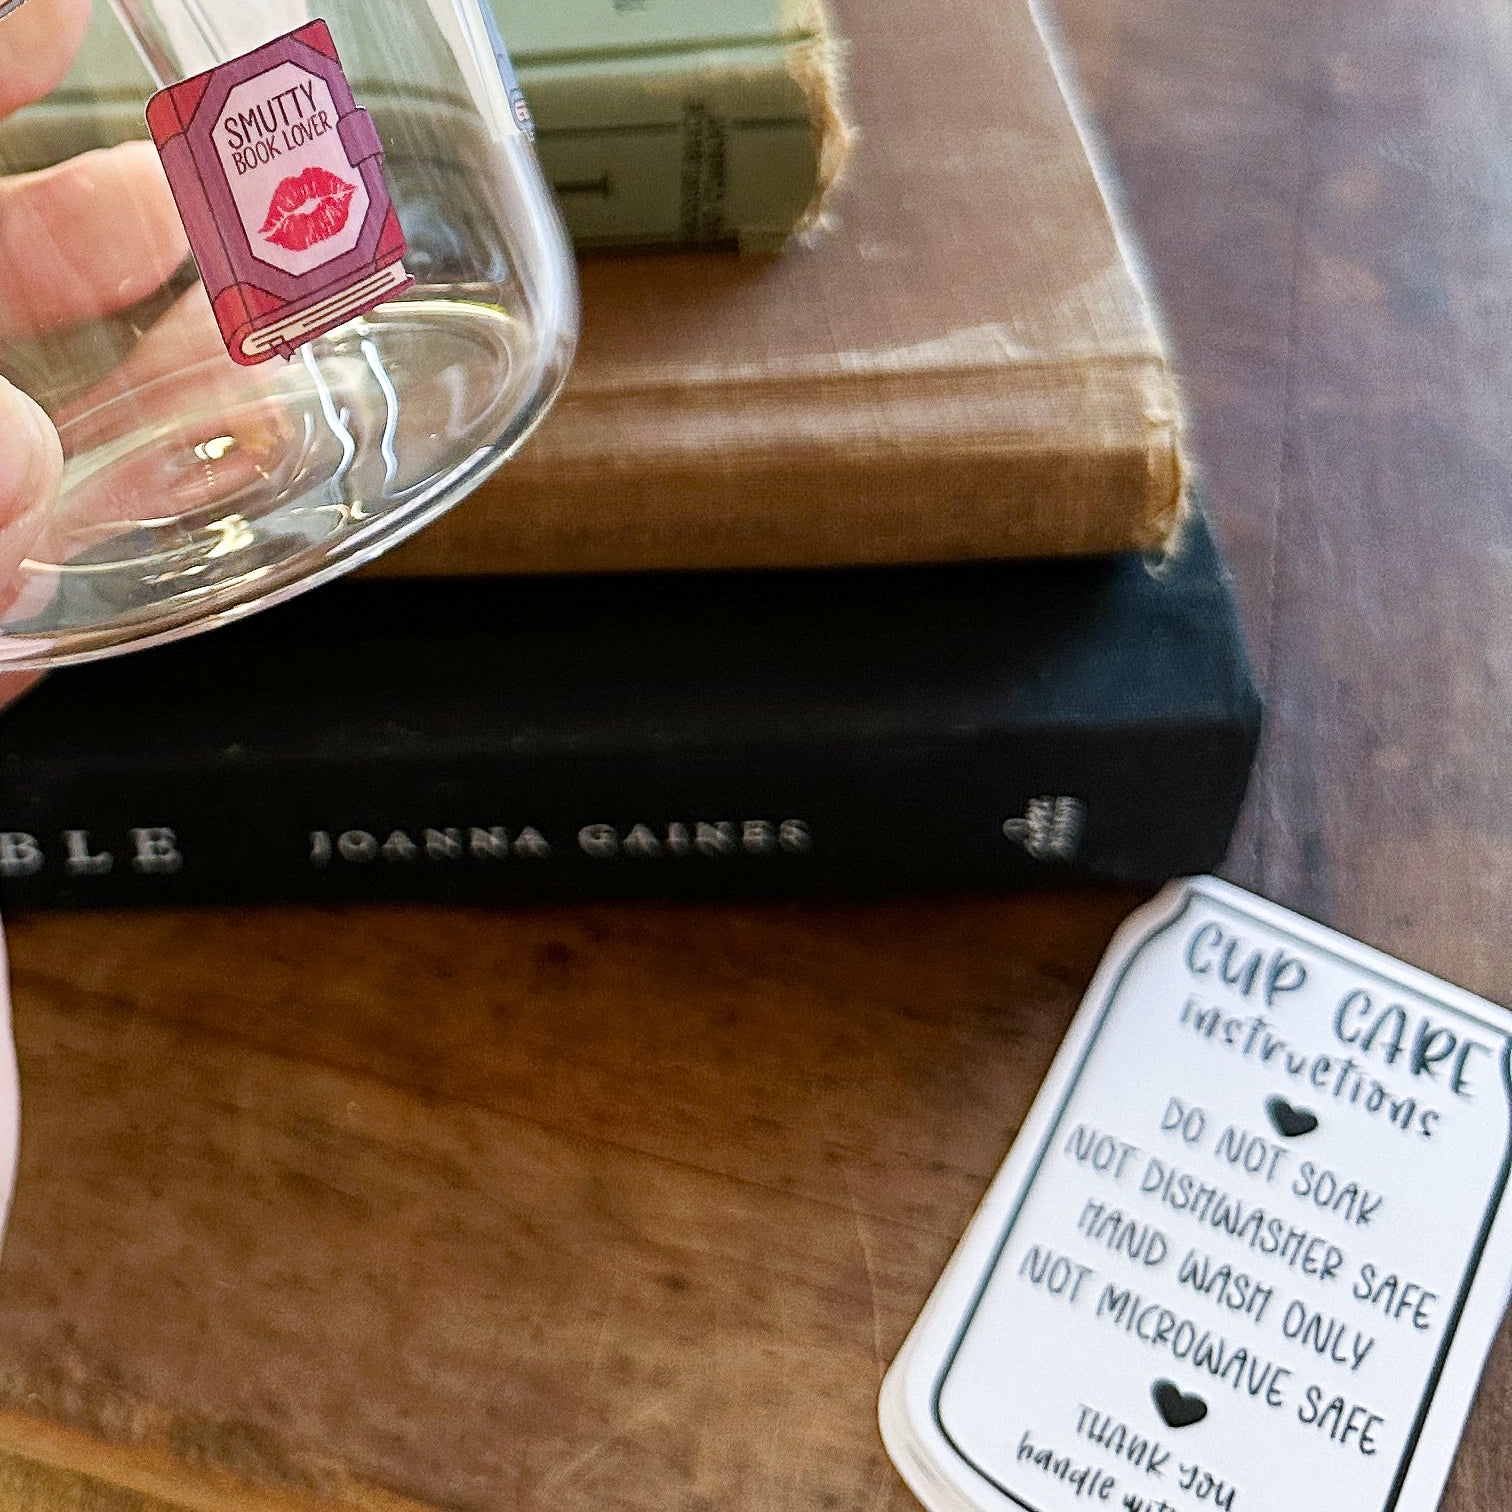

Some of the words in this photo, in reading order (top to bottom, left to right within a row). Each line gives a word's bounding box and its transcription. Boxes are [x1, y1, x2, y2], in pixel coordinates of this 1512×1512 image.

[223, 77, 317, 150] SMUTTY
[231, 134, 283, 176] BOOK
[281, 109, 333, 151] LOVER
[308, 824, 552, 868] JOANNA
[577, 817, 812, 861] GAINES
[1178, 994, 1440, 1138] instructions
[1183, 920, 1307, 1008] CUP
[1332, 985, 1495, 1098] CARE
[1160, 1096, 1207, 1144] DO
[1214, 1124, 1291, 1183] NOT
[1291, 1160, 1384, 1226] SOAK
[1063, 1123, 1141, 1180] NOT
[1140, 1157, 1344, 1280] DISHWASHER
[1352, 1262, 1439, 1331] SAFE
[1077, 1197, 1168, 1266] HAND
[1177, 1247, 1274, 1323] WASH
[1282, 1299, 1375, 1371] ONLY
[1018, 1243, 1094, 1304] NOT
[1095, 1282, 1293, 1408] MICROWAVE
[1297, 1384, 1385, 1456] SAFE
[1016, 1429, 1116, 1501] handle
[1075, 1402, 1172, 1477] THANK
[1178, 1461, 1237, 1512] you
